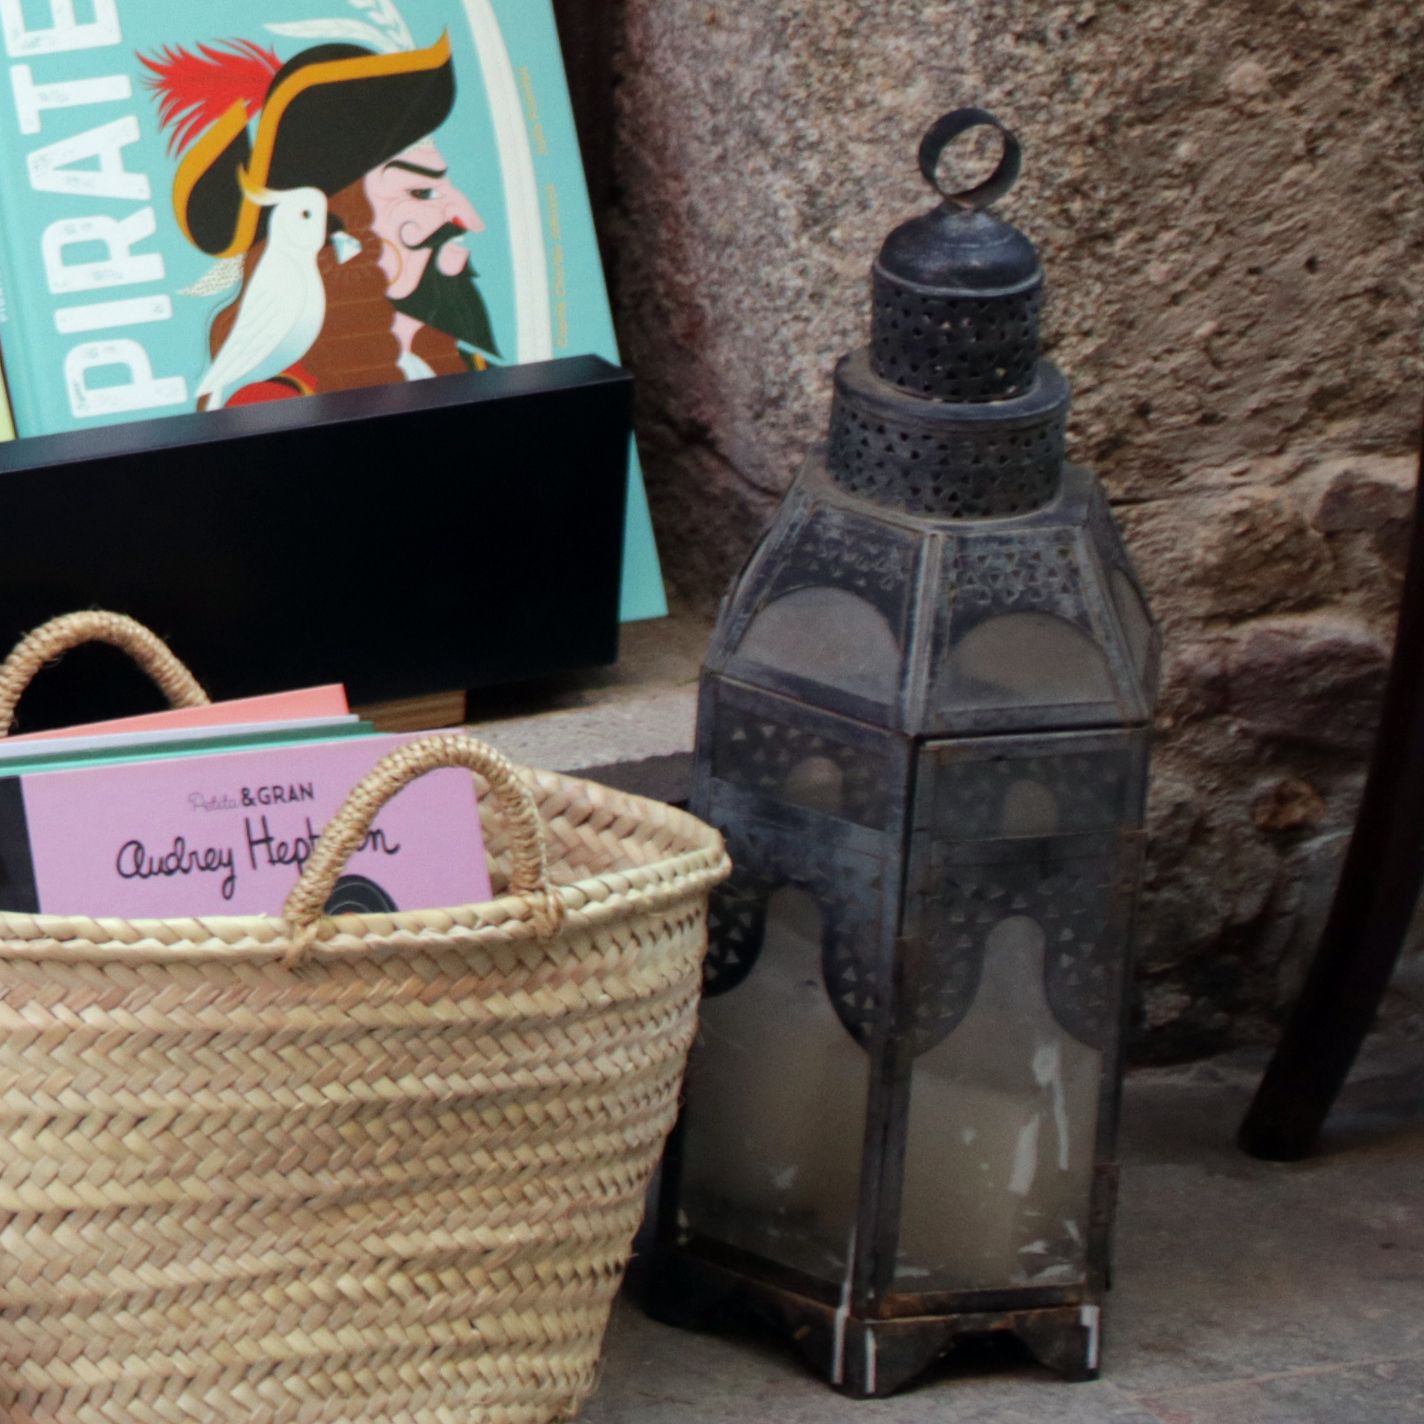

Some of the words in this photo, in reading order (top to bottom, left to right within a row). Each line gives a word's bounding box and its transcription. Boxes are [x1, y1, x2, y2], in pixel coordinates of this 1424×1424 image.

[241, 787, 256, 806] &
[257, 782, 315, 805] GRAN
[117, 838, 234, 900] Audrey
